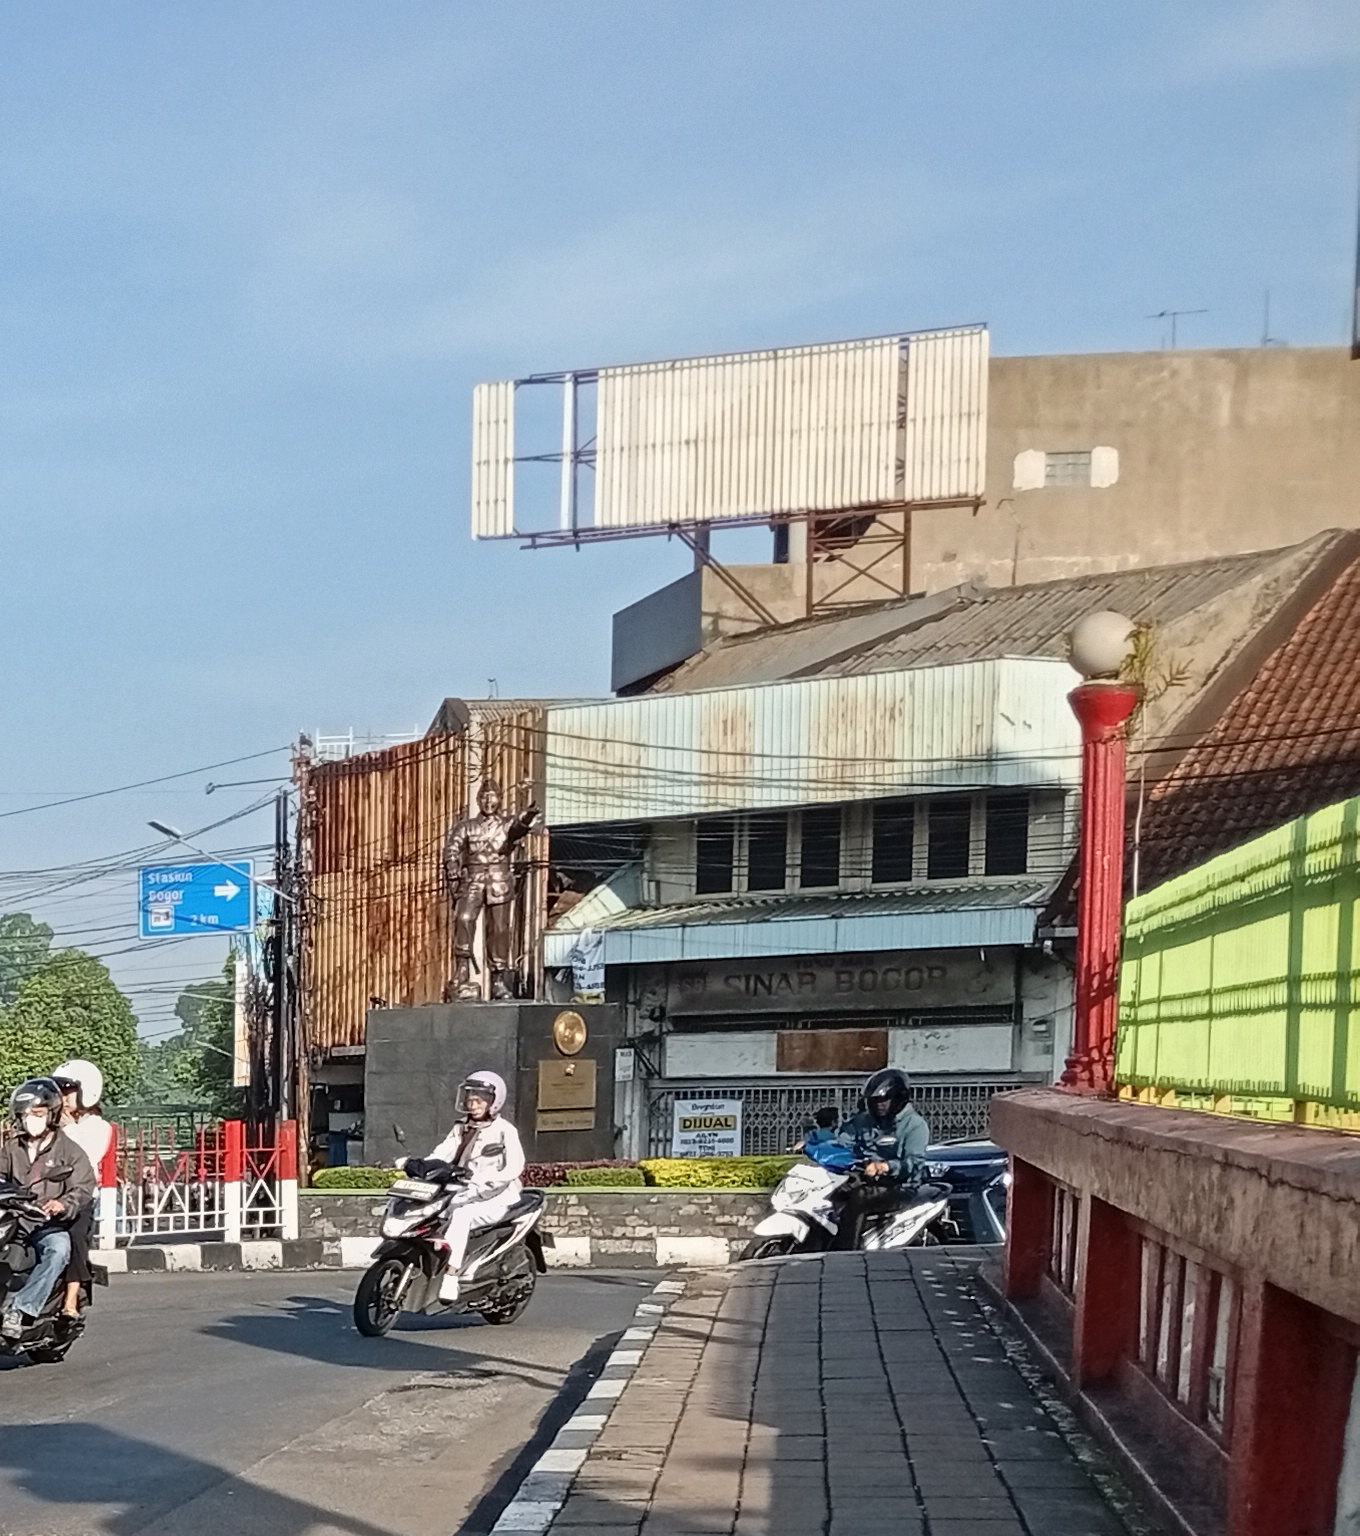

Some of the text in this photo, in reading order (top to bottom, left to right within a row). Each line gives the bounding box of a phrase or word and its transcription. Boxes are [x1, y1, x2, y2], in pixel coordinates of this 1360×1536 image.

[147, 871, 193, 884] Stasiun
[148, 889, 184, 904] Bogor
[200, 913, 219, 925] km
[723, 965, 947, 997] SINAR BOGOR
[682, 1117, 732, 1129] DIJUAL
